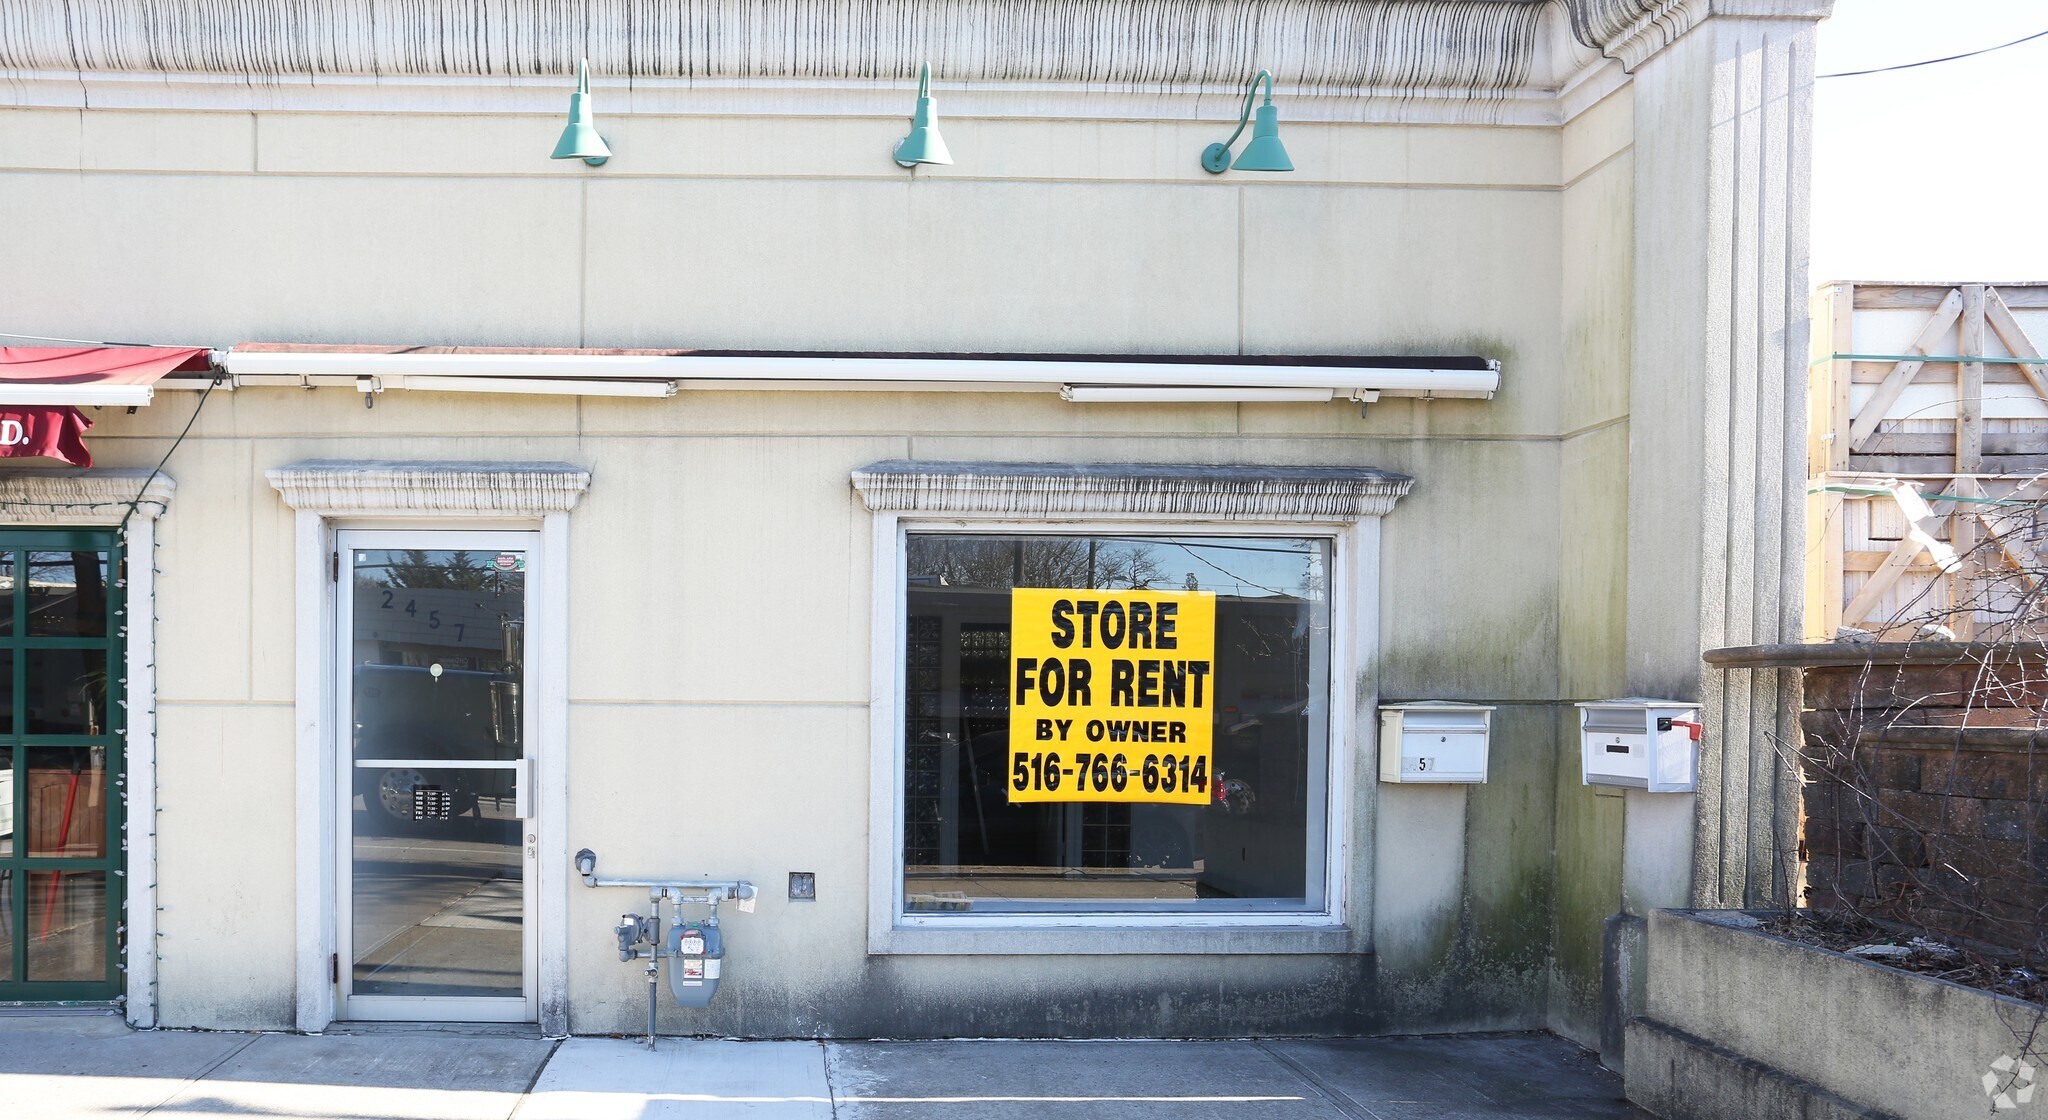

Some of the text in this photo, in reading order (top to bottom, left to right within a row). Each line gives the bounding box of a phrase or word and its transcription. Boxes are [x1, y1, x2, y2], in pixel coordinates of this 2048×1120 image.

[1051, 599, 1178, 649] STORE
[1016, 657, 1210, 708] FOR RENT
[1036, 719, 1186, 743] BY OWNER
[1012, 752, 1208, 794] 516-766-6314
